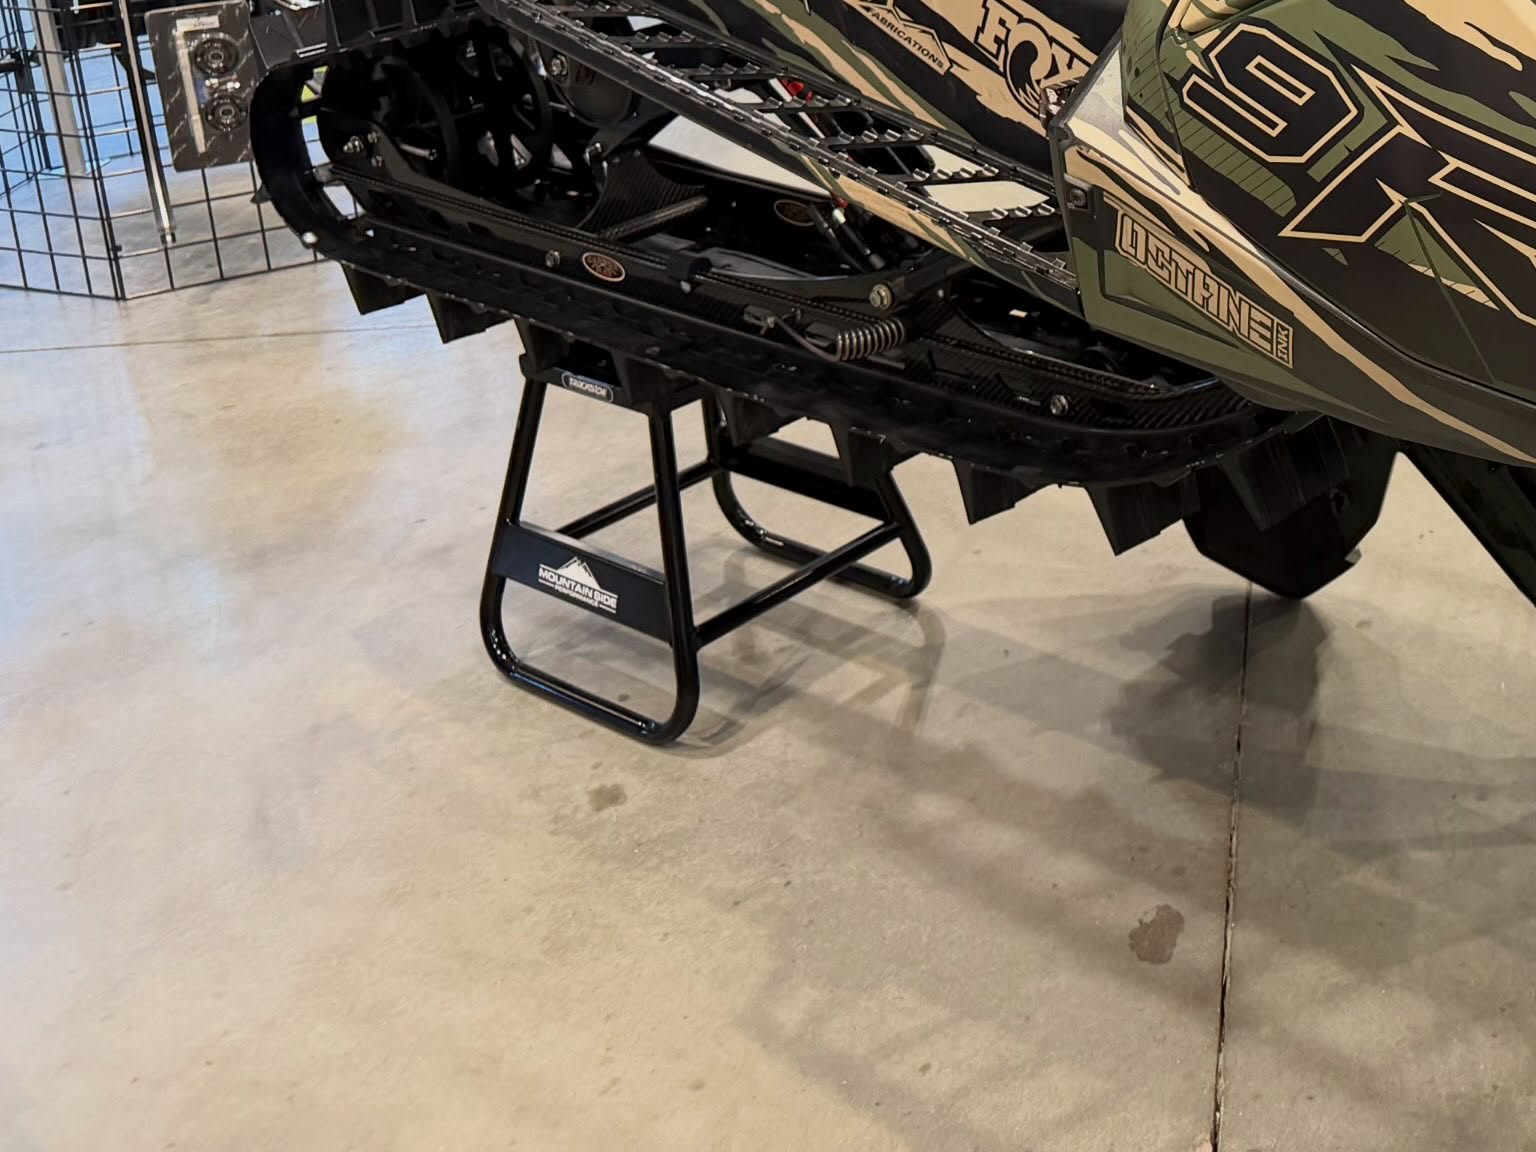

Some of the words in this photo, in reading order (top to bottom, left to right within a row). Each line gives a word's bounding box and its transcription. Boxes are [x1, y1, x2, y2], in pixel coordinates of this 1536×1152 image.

[1116, 210, 1275, 358] OCTANE
[1277, 325, 1290, 361] INK
[538, 567, 594, 599] MOUNTAIN
[593, 590, 617, 609] SIDE
